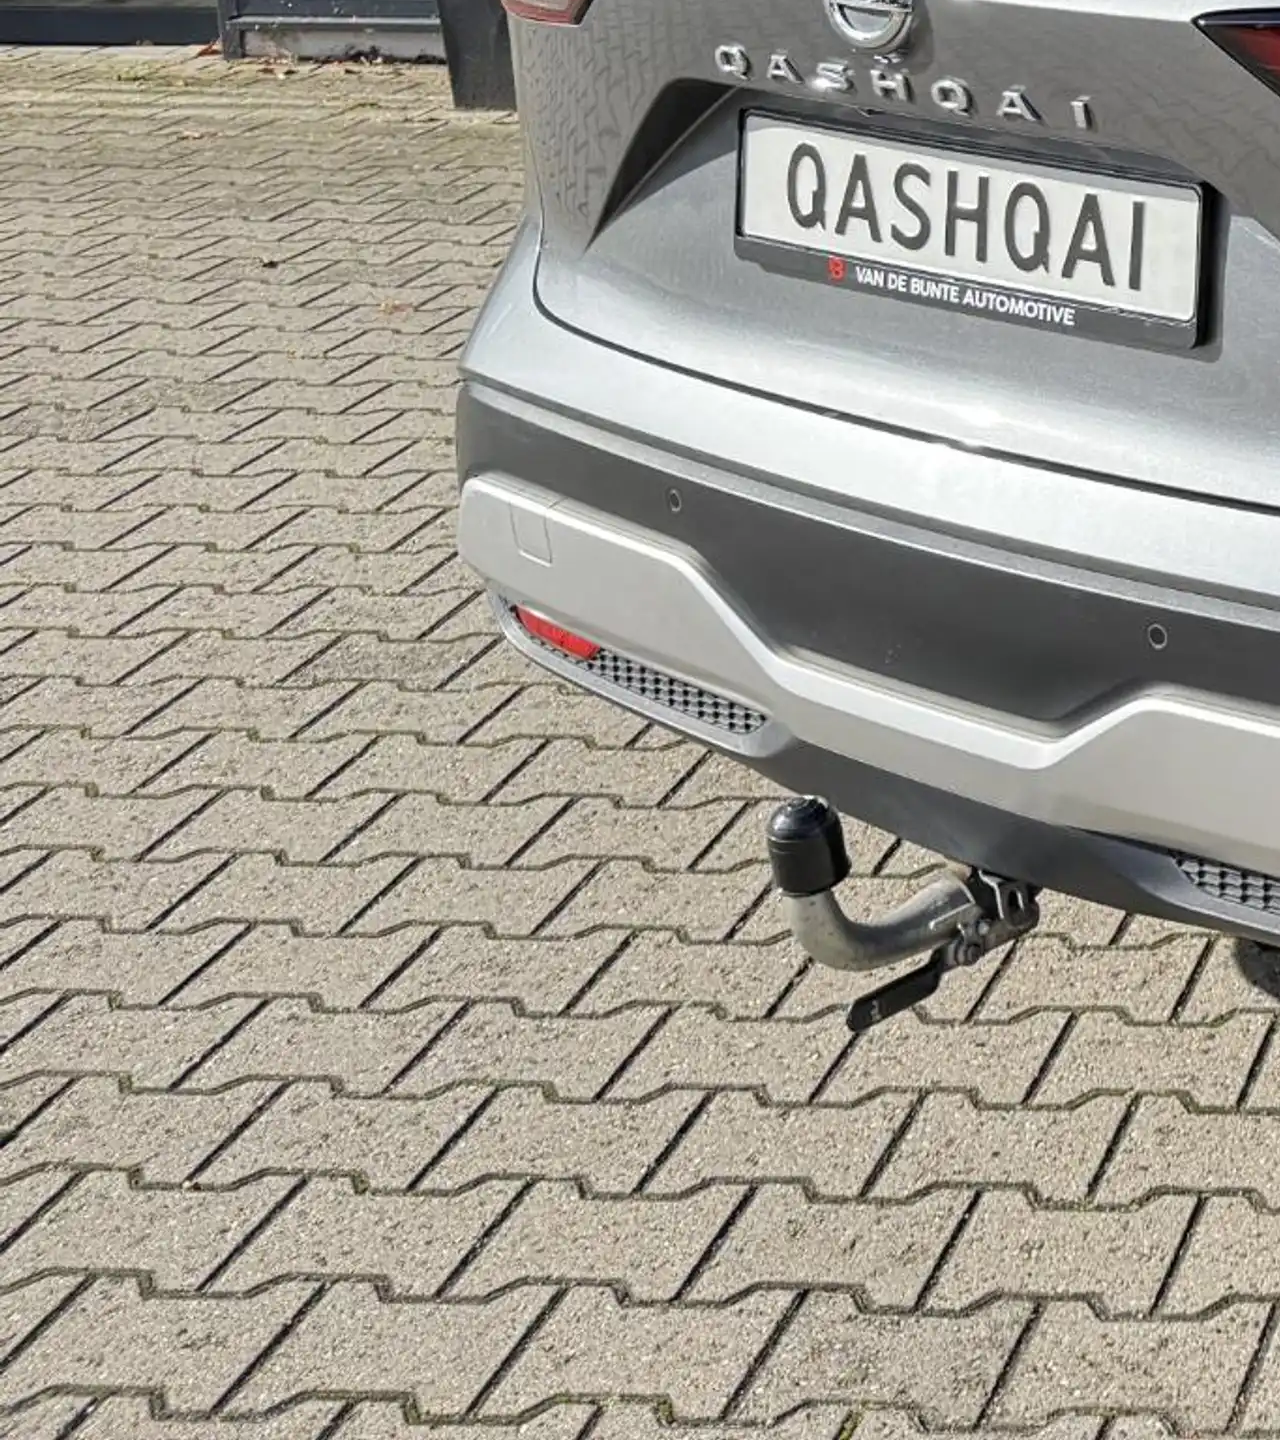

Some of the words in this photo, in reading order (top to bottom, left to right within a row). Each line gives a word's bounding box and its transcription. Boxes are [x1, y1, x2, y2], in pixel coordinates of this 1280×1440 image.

[714, 42, 1094, 131] QASHQAI
[787, 142, 1147, 291] QASHQAI
[855, 264, 884, 288] VAN
[887, 271, 907, 292] DE
[910, 277, 960, 304] BUNTE
[962, 288, 1076, 326] AUTOMOTIVE
